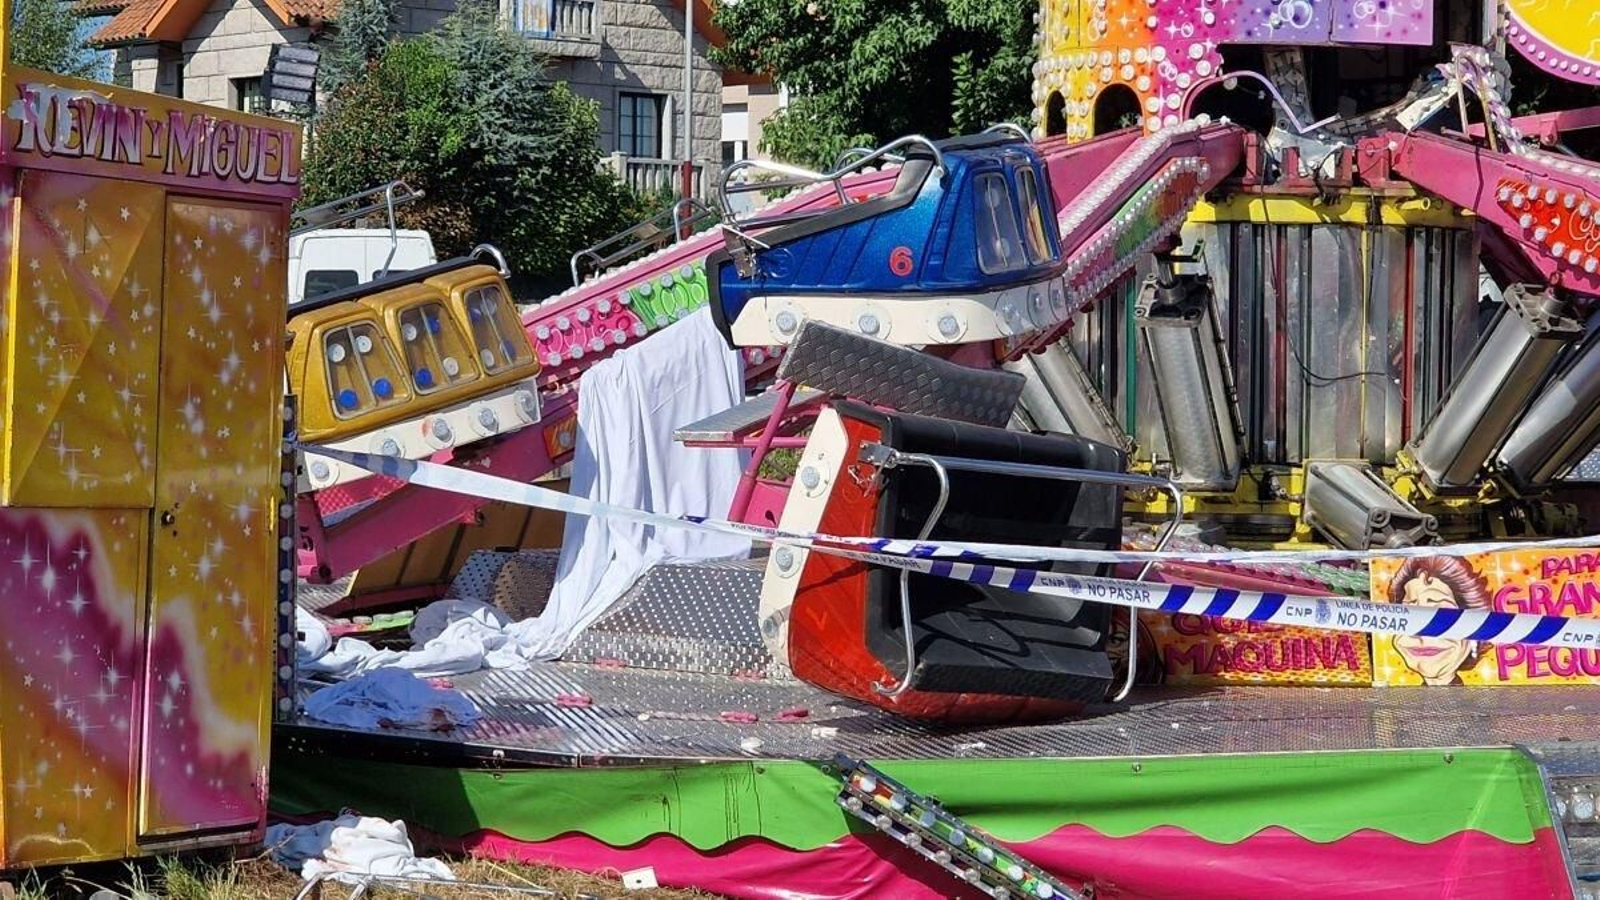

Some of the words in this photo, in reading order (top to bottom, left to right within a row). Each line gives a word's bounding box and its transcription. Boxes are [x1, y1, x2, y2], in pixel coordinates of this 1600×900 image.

[17, 84, 146, 164] KEVIN
[147, 119, 167, 158] Y
[164, 111, 298, 185] MIGUEL
[889, 246, 913, 276] 6
[1088, 583, 1106, 598] NO
[1109, 586, 1151, 603] PASAR
[1286, 606, 1313, 617] CNP
[1362, 603, 1374, 612] DE
[1337, 612, 1357, 627] NO
[1361, 614, 1408, 632] PASAR
[1563, 632, 1594, 642] CNP
[1163, 633, 1360, 674] MAQUINA
